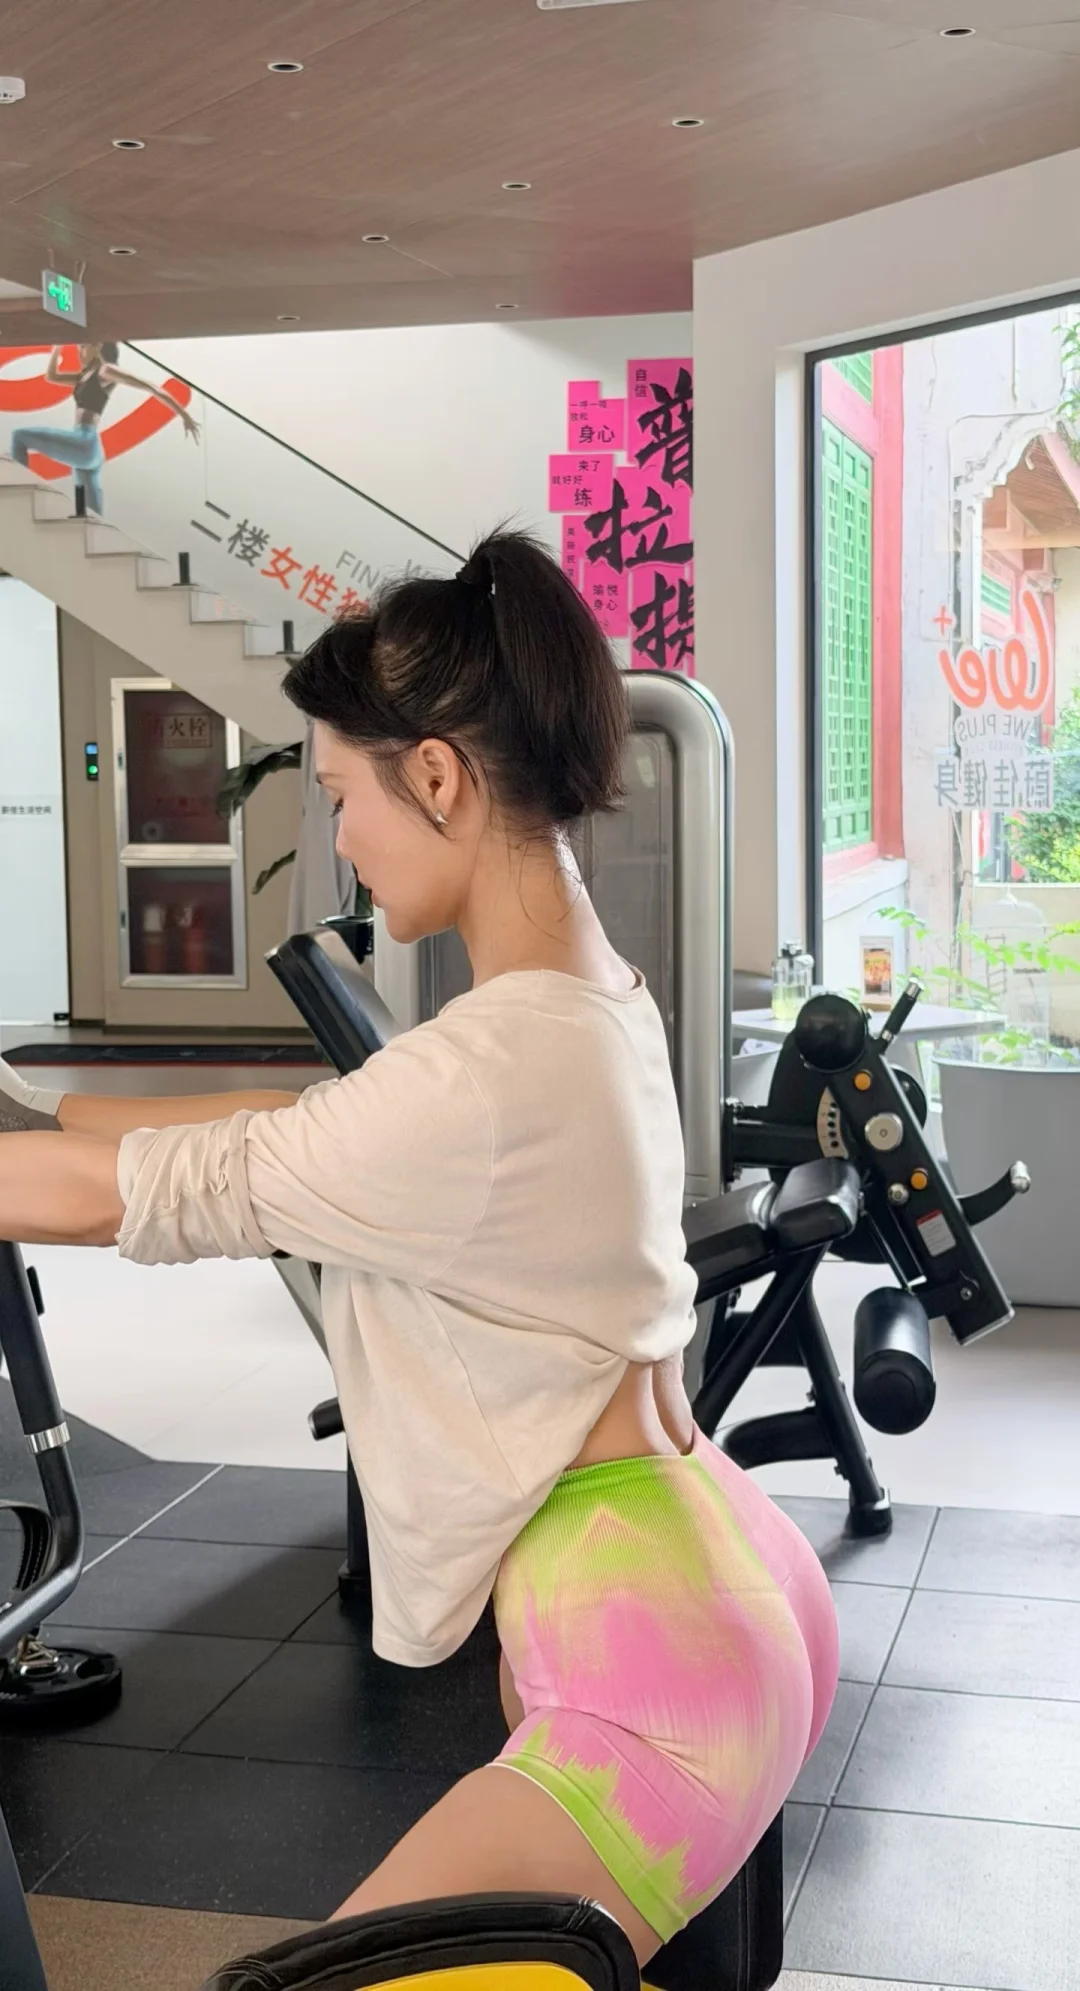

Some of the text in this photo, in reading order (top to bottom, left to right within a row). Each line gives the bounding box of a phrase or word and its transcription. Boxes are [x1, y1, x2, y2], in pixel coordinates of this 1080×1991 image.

[578, 424, 616, 444] 身心
[578, 460, 601, 472] 来了
[574, 488, 592, 508] 练
